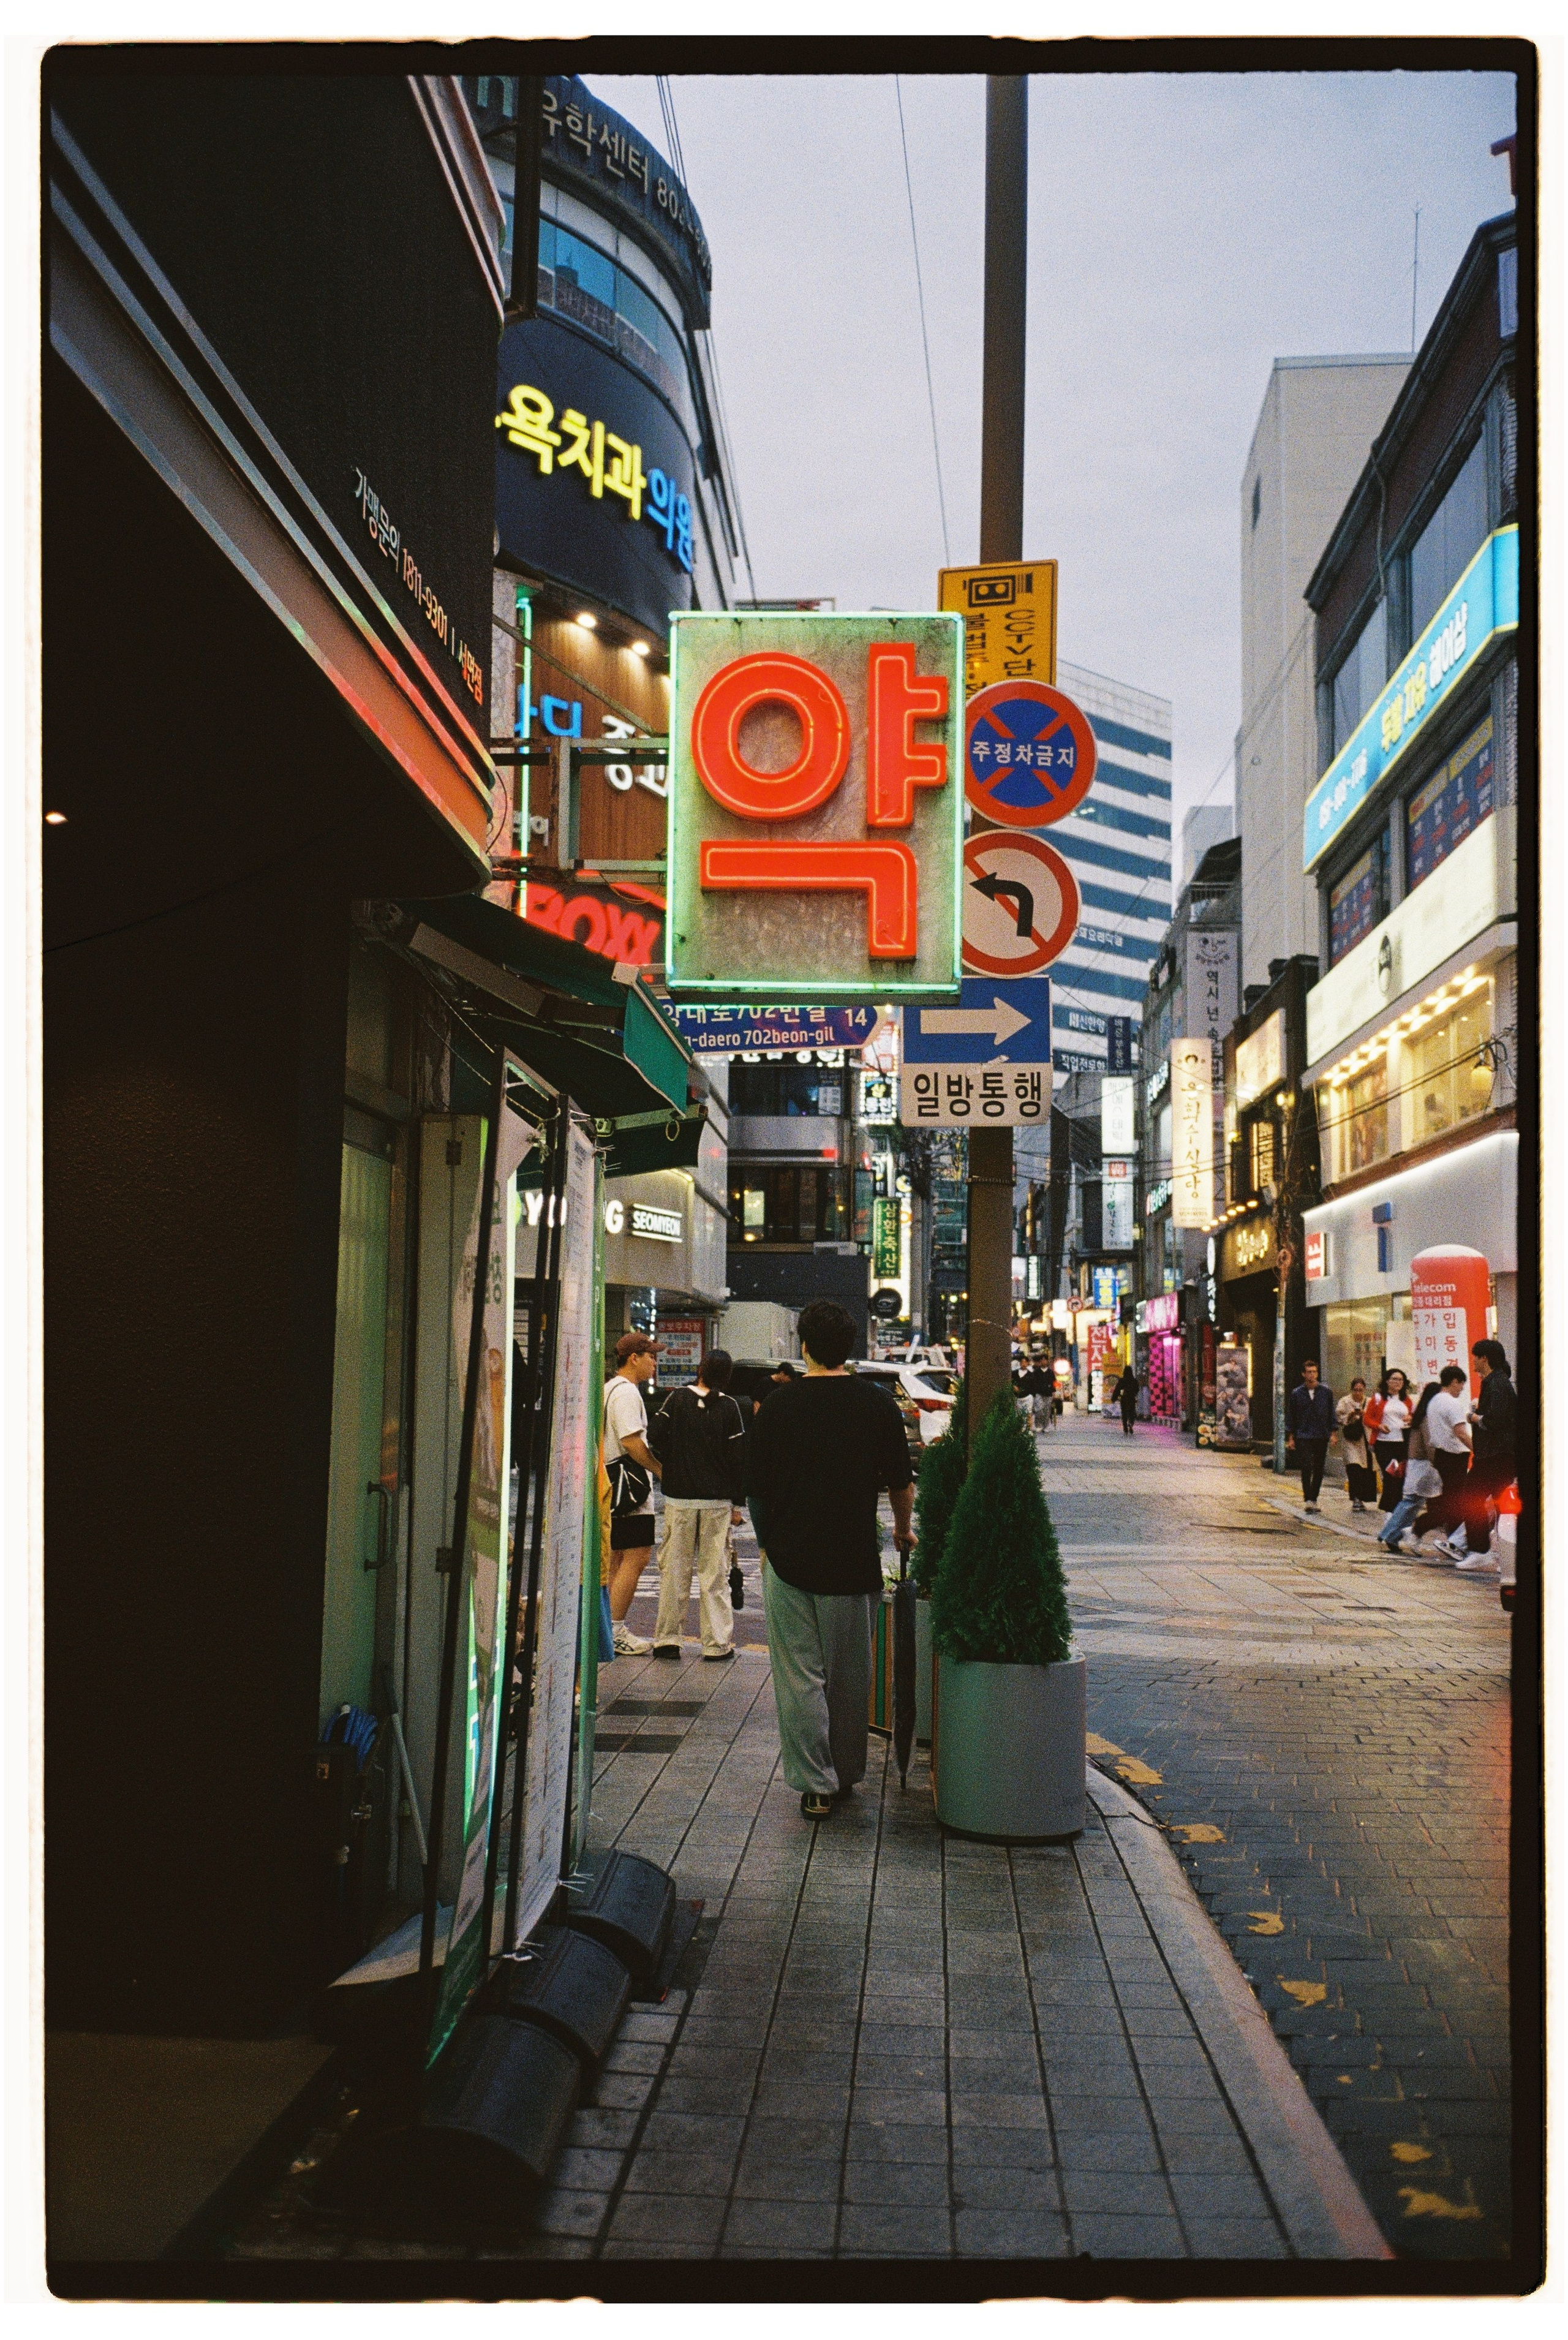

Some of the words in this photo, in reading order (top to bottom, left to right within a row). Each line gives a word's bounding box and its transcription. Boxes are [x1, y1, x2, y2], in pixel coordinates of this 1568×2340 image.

[495, 384, 693, 573] 욕치과의원
[352, 466, 401, 573] 가맹문의
[402, 547, 448, 646] 1811-9301
[458, 640, 483, 706] 서면점
[971, 740, 1074, 768] 주정차금지
[691, 643, 948, 959] 약
[743, 1025, 835, 1046] 702beon-gil
[845, 1008, 868, 1027] 14
[913, 1071, 1042, 1118] 일방통행
[633, 1210, 681, 1237] SEOMYEON
